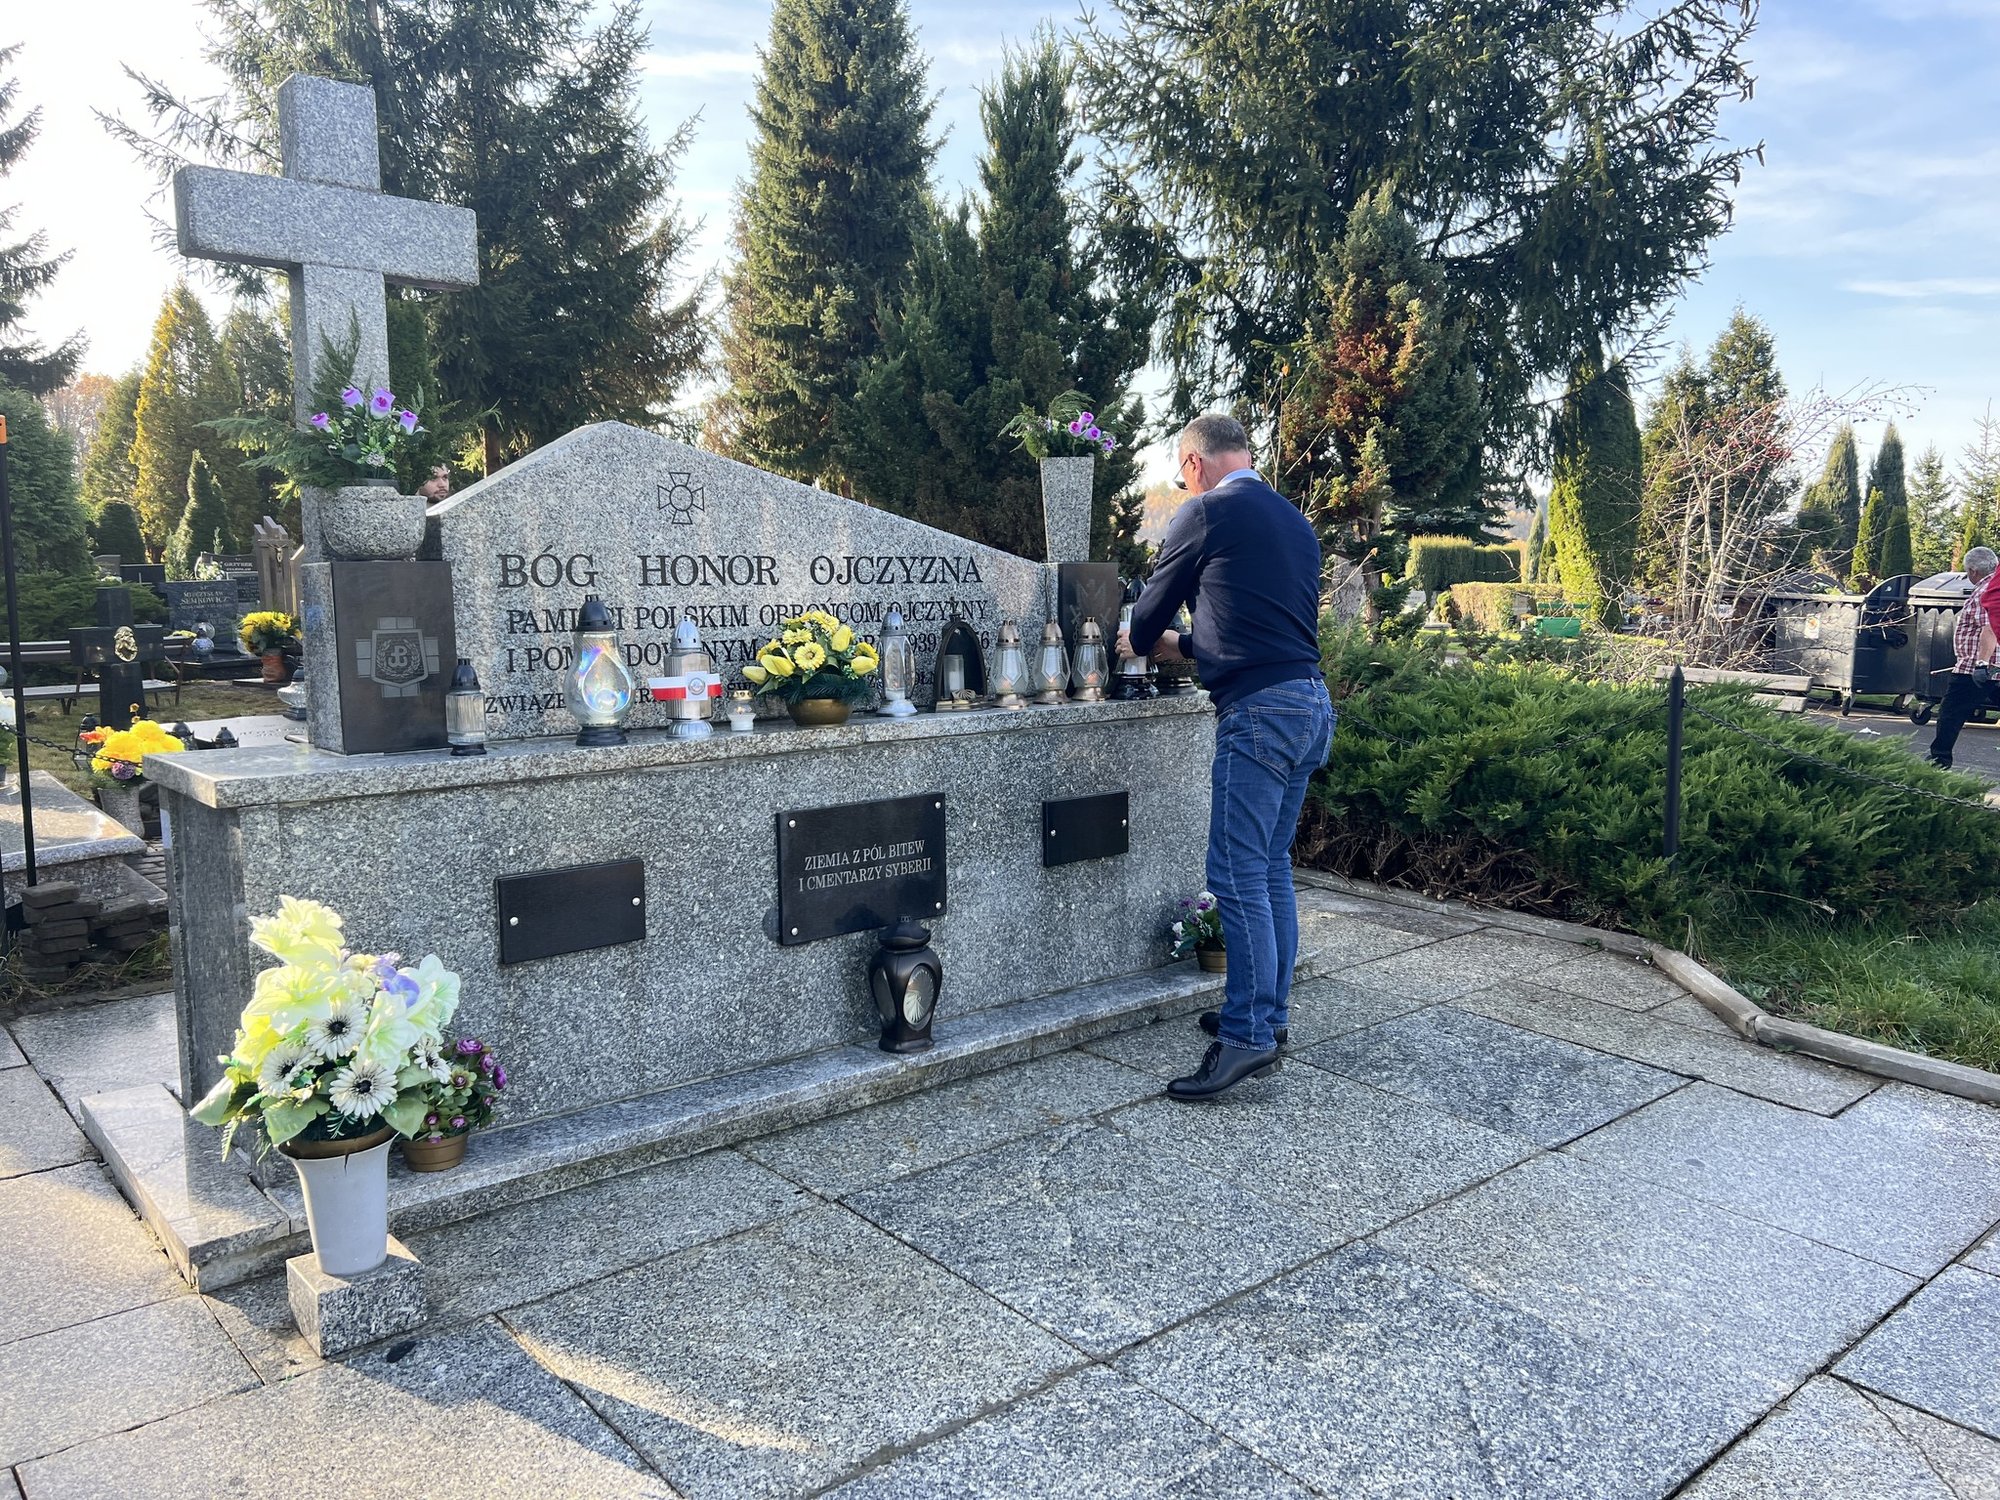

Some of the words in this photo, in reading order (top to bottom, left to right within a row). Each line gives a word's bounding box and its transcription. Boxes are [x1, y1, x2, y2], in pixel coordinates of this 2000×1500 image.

[496, 545, 599, 588] BÓG
[637, 554, 779, 587] HONOR
[810, 555, 984, 585] OJCZYZNA
[506, 607, 626, 634] PAMII
[634, 604, 749, 630] POLSKIM
[507, 648, 516, 673] I
[908, 632, 937, 654] 939
[485, 692, 567, 714] ZWIĄZE
[804, 852, 850, 871] ZIEMIA
[852, 849, 861, 864] Z
[863, 843, 886, 862] PÓL
[888, 839, 925, 858] BITEW
[799, 877, 804, 892] I
[806, 865, 883, 890] CMENTARZY
[885, 857, 932, 878] SYBERII
